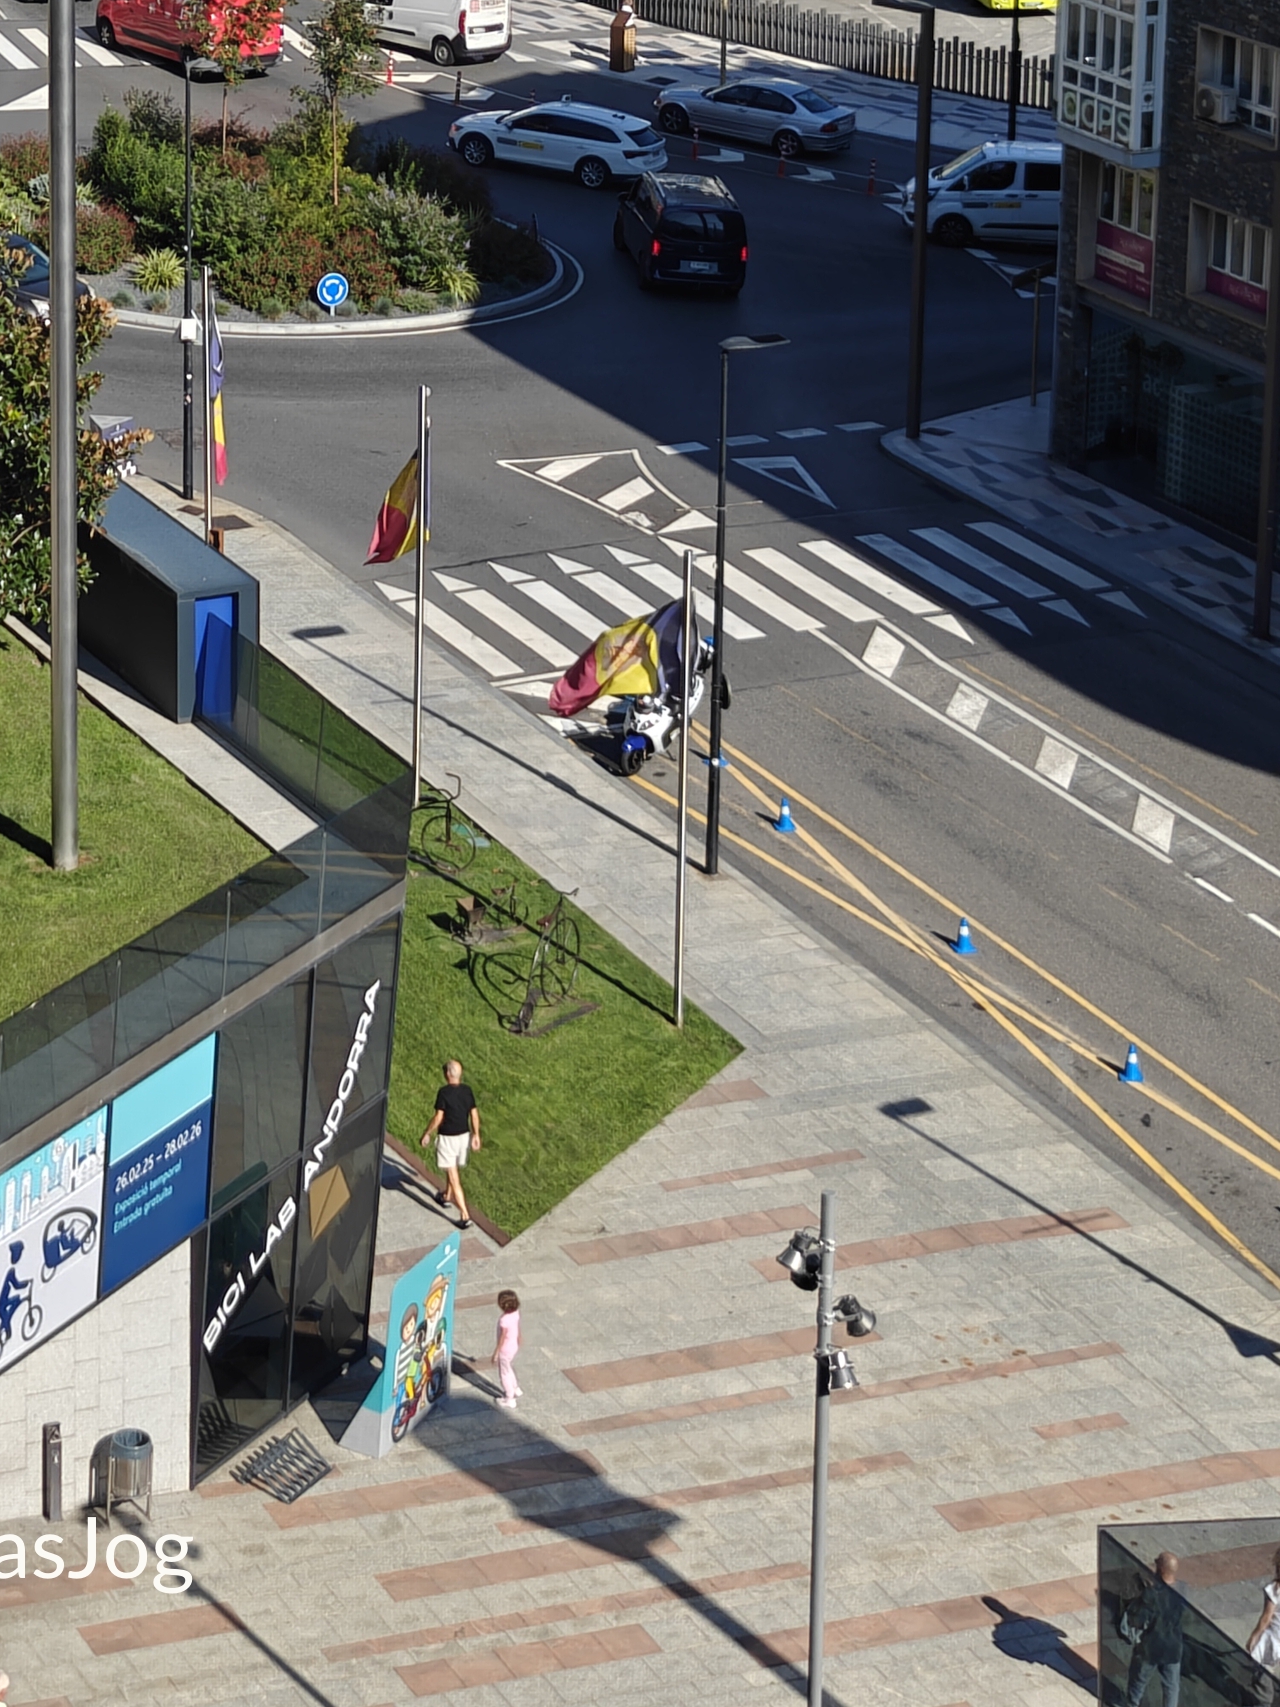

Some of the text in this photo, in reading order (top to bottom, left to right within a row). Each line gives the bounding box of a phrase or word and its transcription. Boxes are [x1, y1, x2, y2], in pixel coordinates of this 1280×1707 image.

[114, 1152, 155, 1194] 26.02.25
[164, 1120, 202, 1159] 28.02.26
[114, 1158, 182, 1216] Exposició temporal
[202, 978, 381, 1354] BICI LAB ANDORRA
[113, 1205, 142, 1234] Entrada
